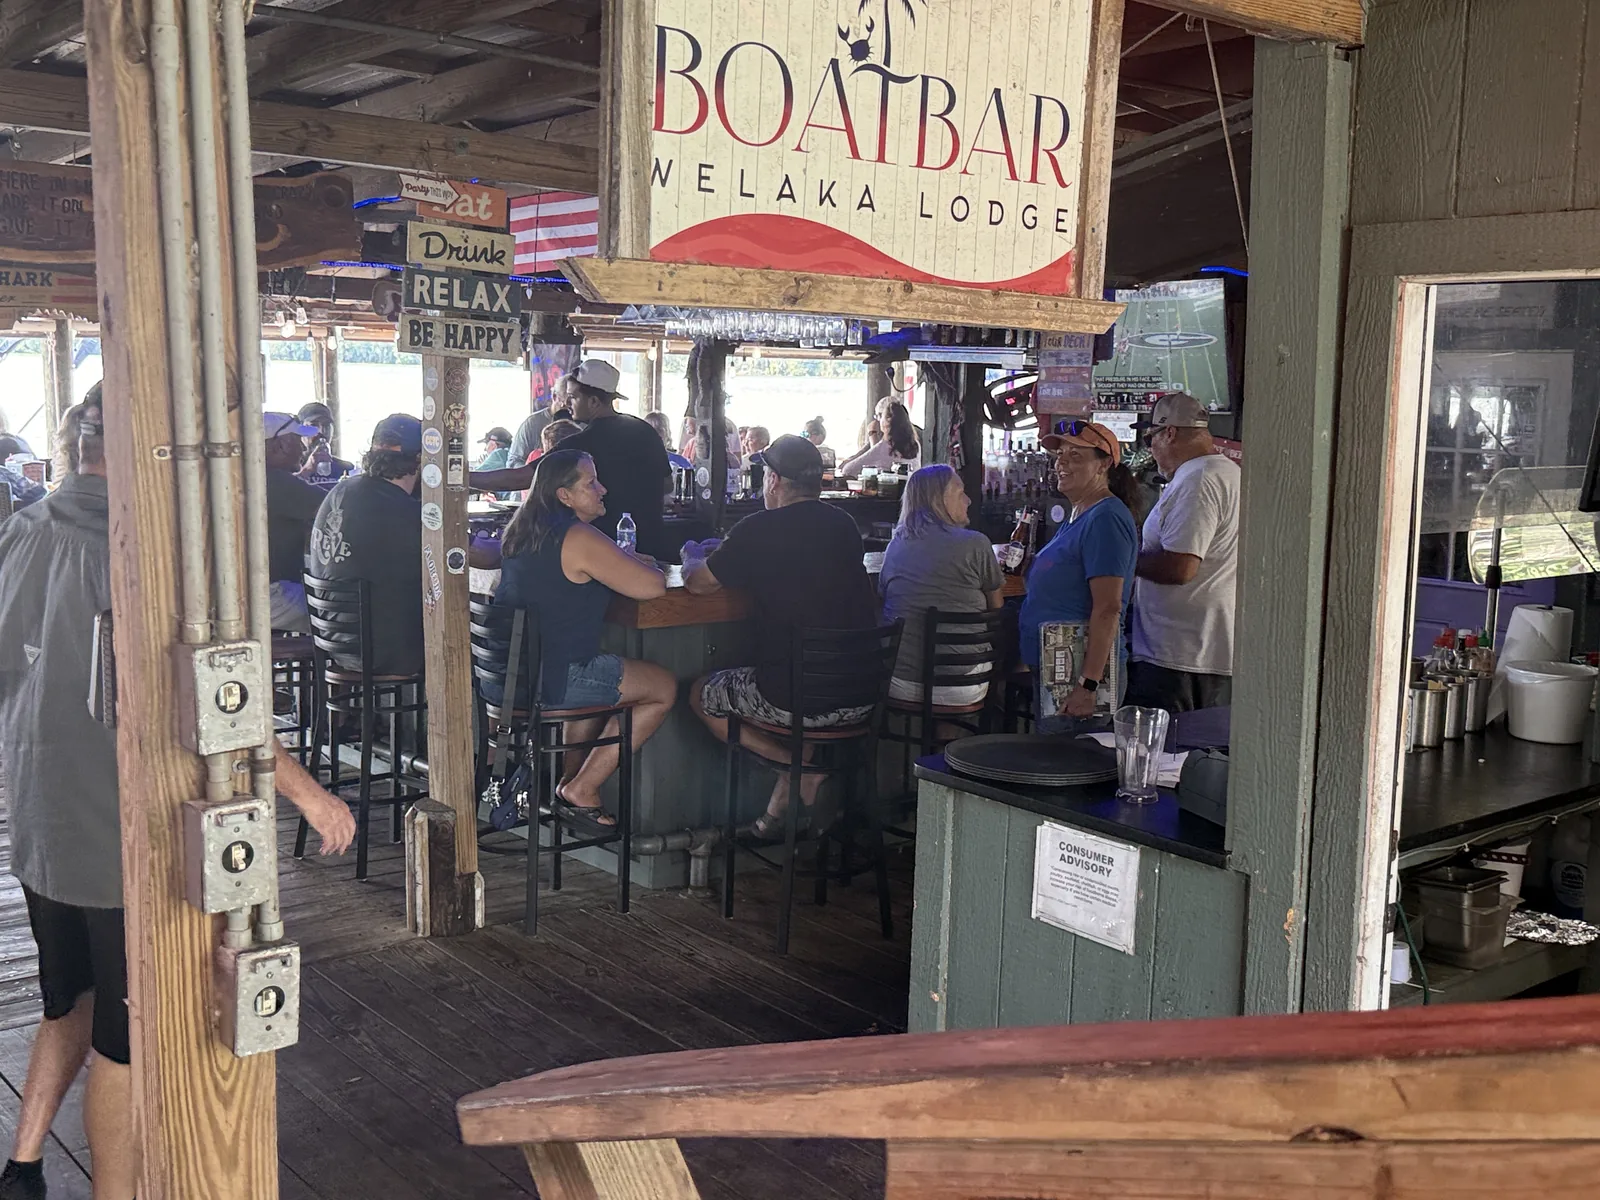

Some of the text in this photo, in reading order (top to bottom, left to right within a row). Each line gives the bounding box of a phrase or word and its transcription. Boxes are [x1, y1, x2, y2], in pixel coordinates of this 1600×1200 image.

[405, 183, 430, 196] Party
[650, 157, 1068, 233] WELAKA LODGE
[419, 232, 506, 266] Drink
[413, 274, 512, 313] RELAX
[409, 320, 514, 354] BE HAPPY
[1059, 841, 1114, 867] CONSUMER
[1059, 854, 1112, 878] ADVISORY
